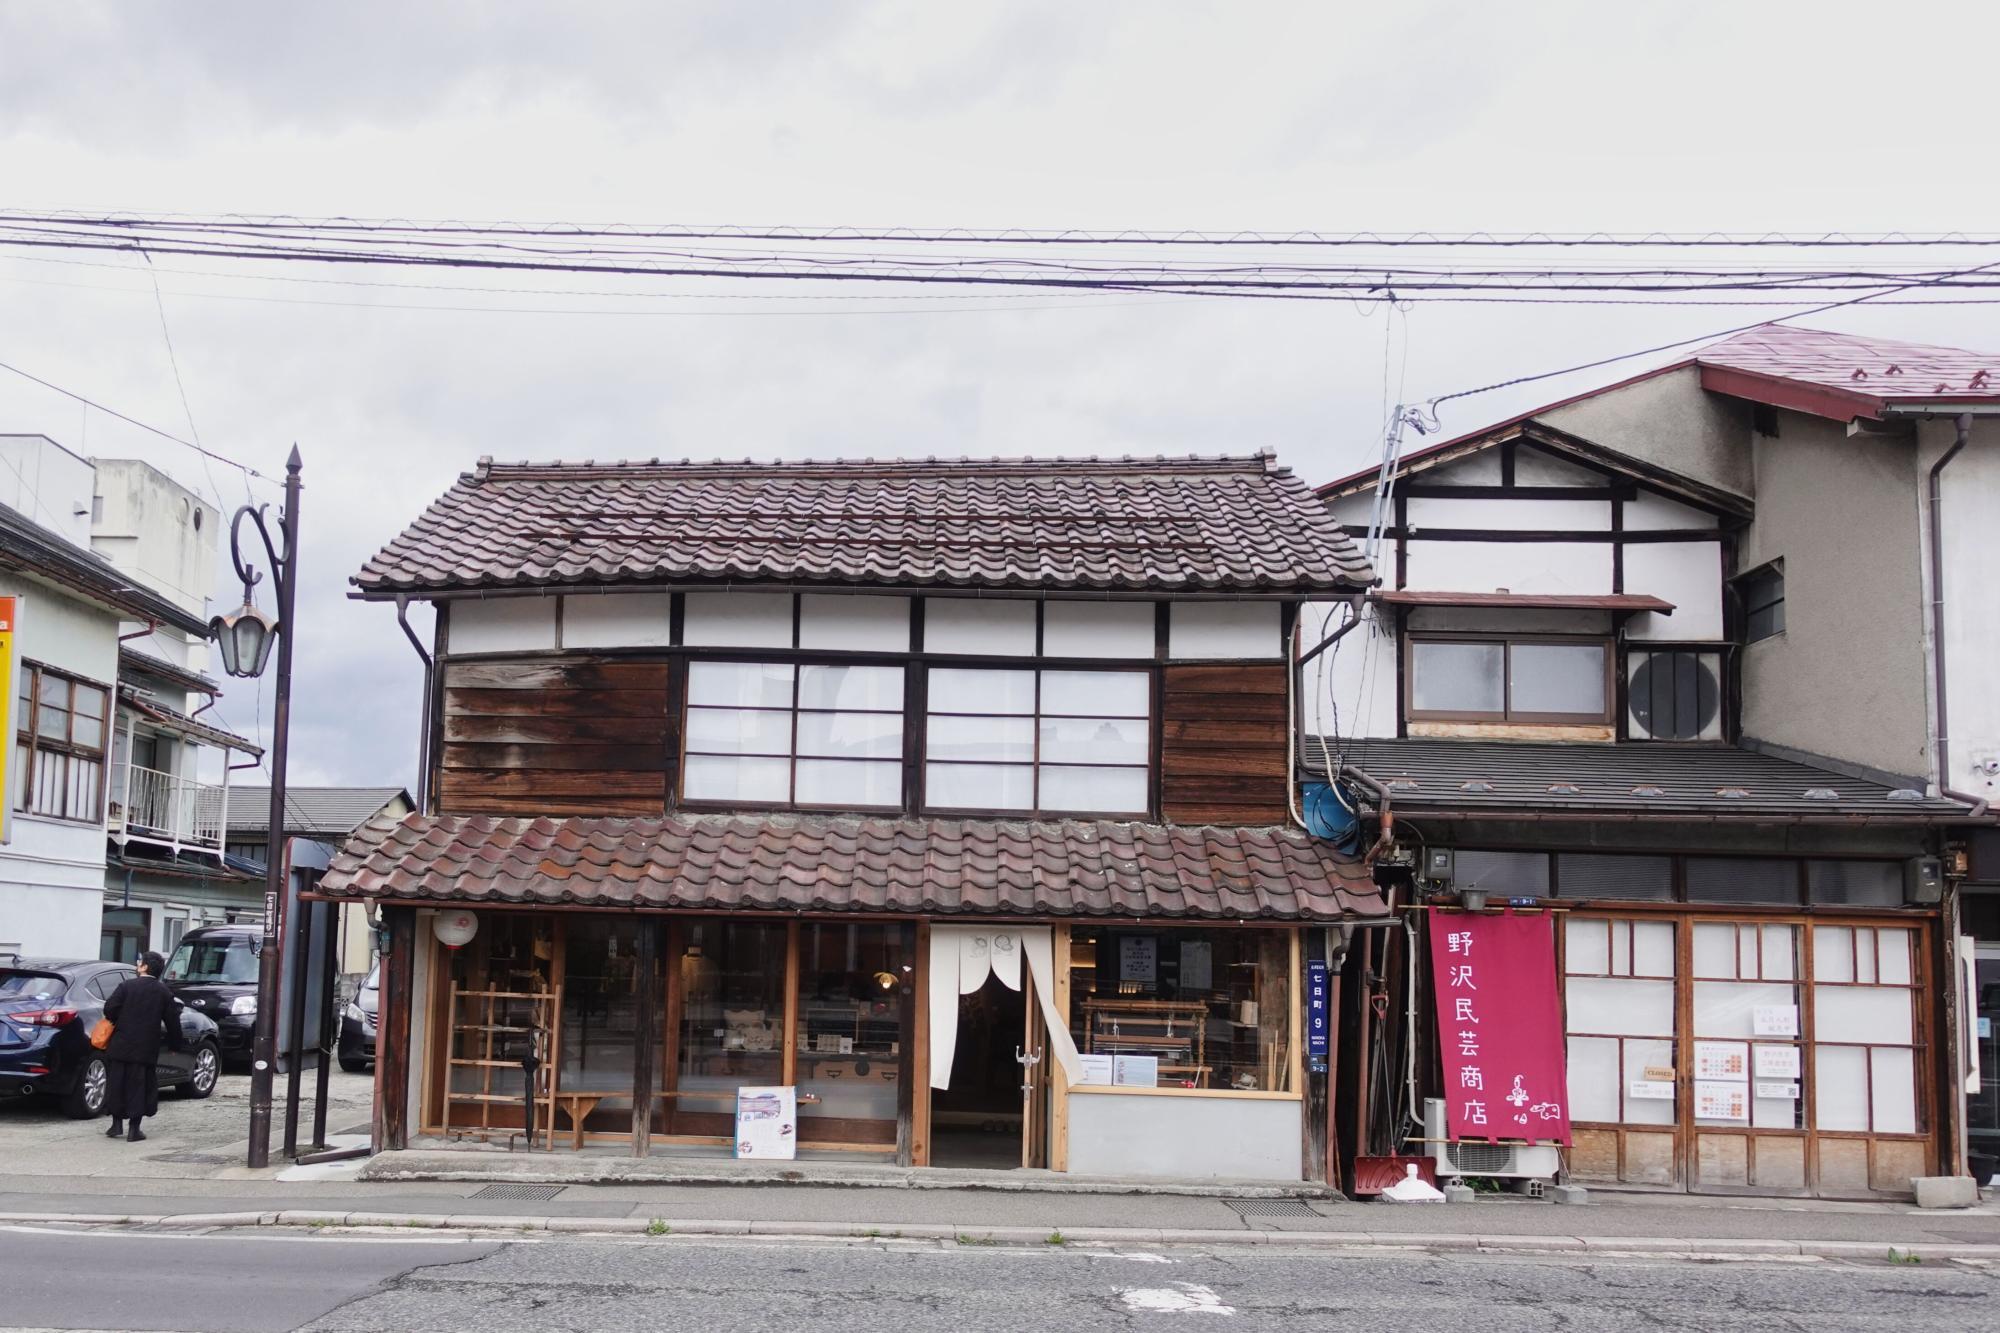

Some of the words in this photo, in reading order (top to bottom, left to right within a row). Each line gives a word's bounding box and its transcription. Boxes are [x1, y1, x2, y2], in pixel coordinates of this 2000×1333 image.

[1313, 974, 1322, 1009] 七日町
[1314, 1018, 1322, 1028] 9
[1448, 931, 1488, 1124] 野沢民芸商店
